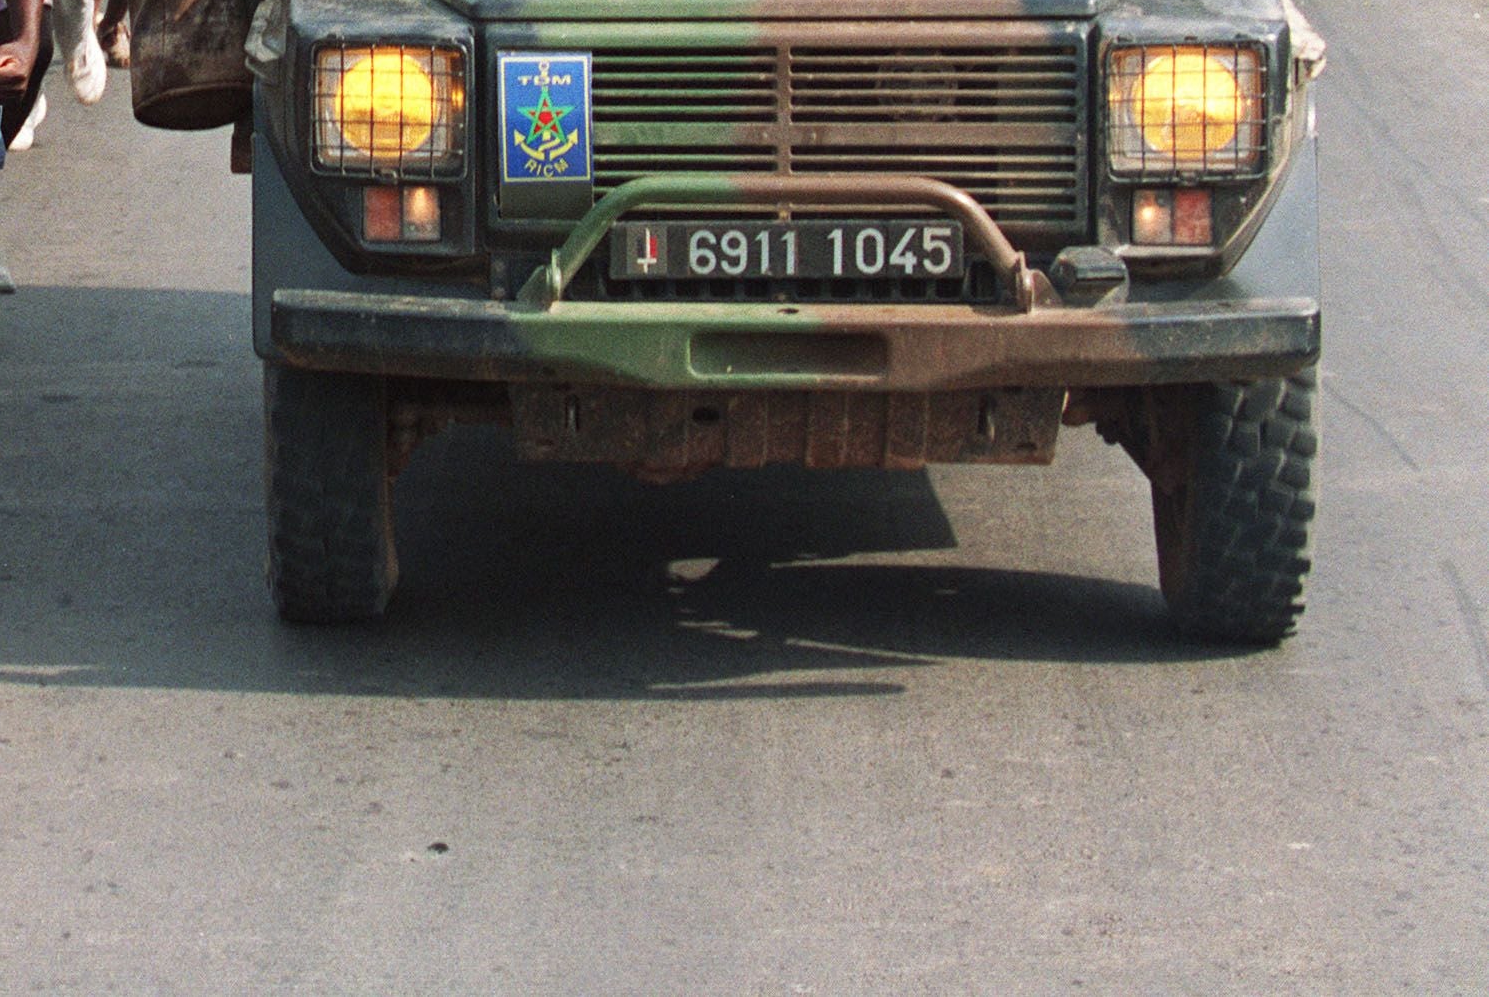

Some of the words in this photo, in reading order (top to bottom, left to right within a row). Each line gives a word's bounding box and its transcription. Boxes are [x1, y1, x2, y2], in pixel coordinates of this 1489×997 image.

[524, 158, 570, 177] RICM
[689, 230, 798, 275] 6911
[827, 227, 951, 276] 1045
